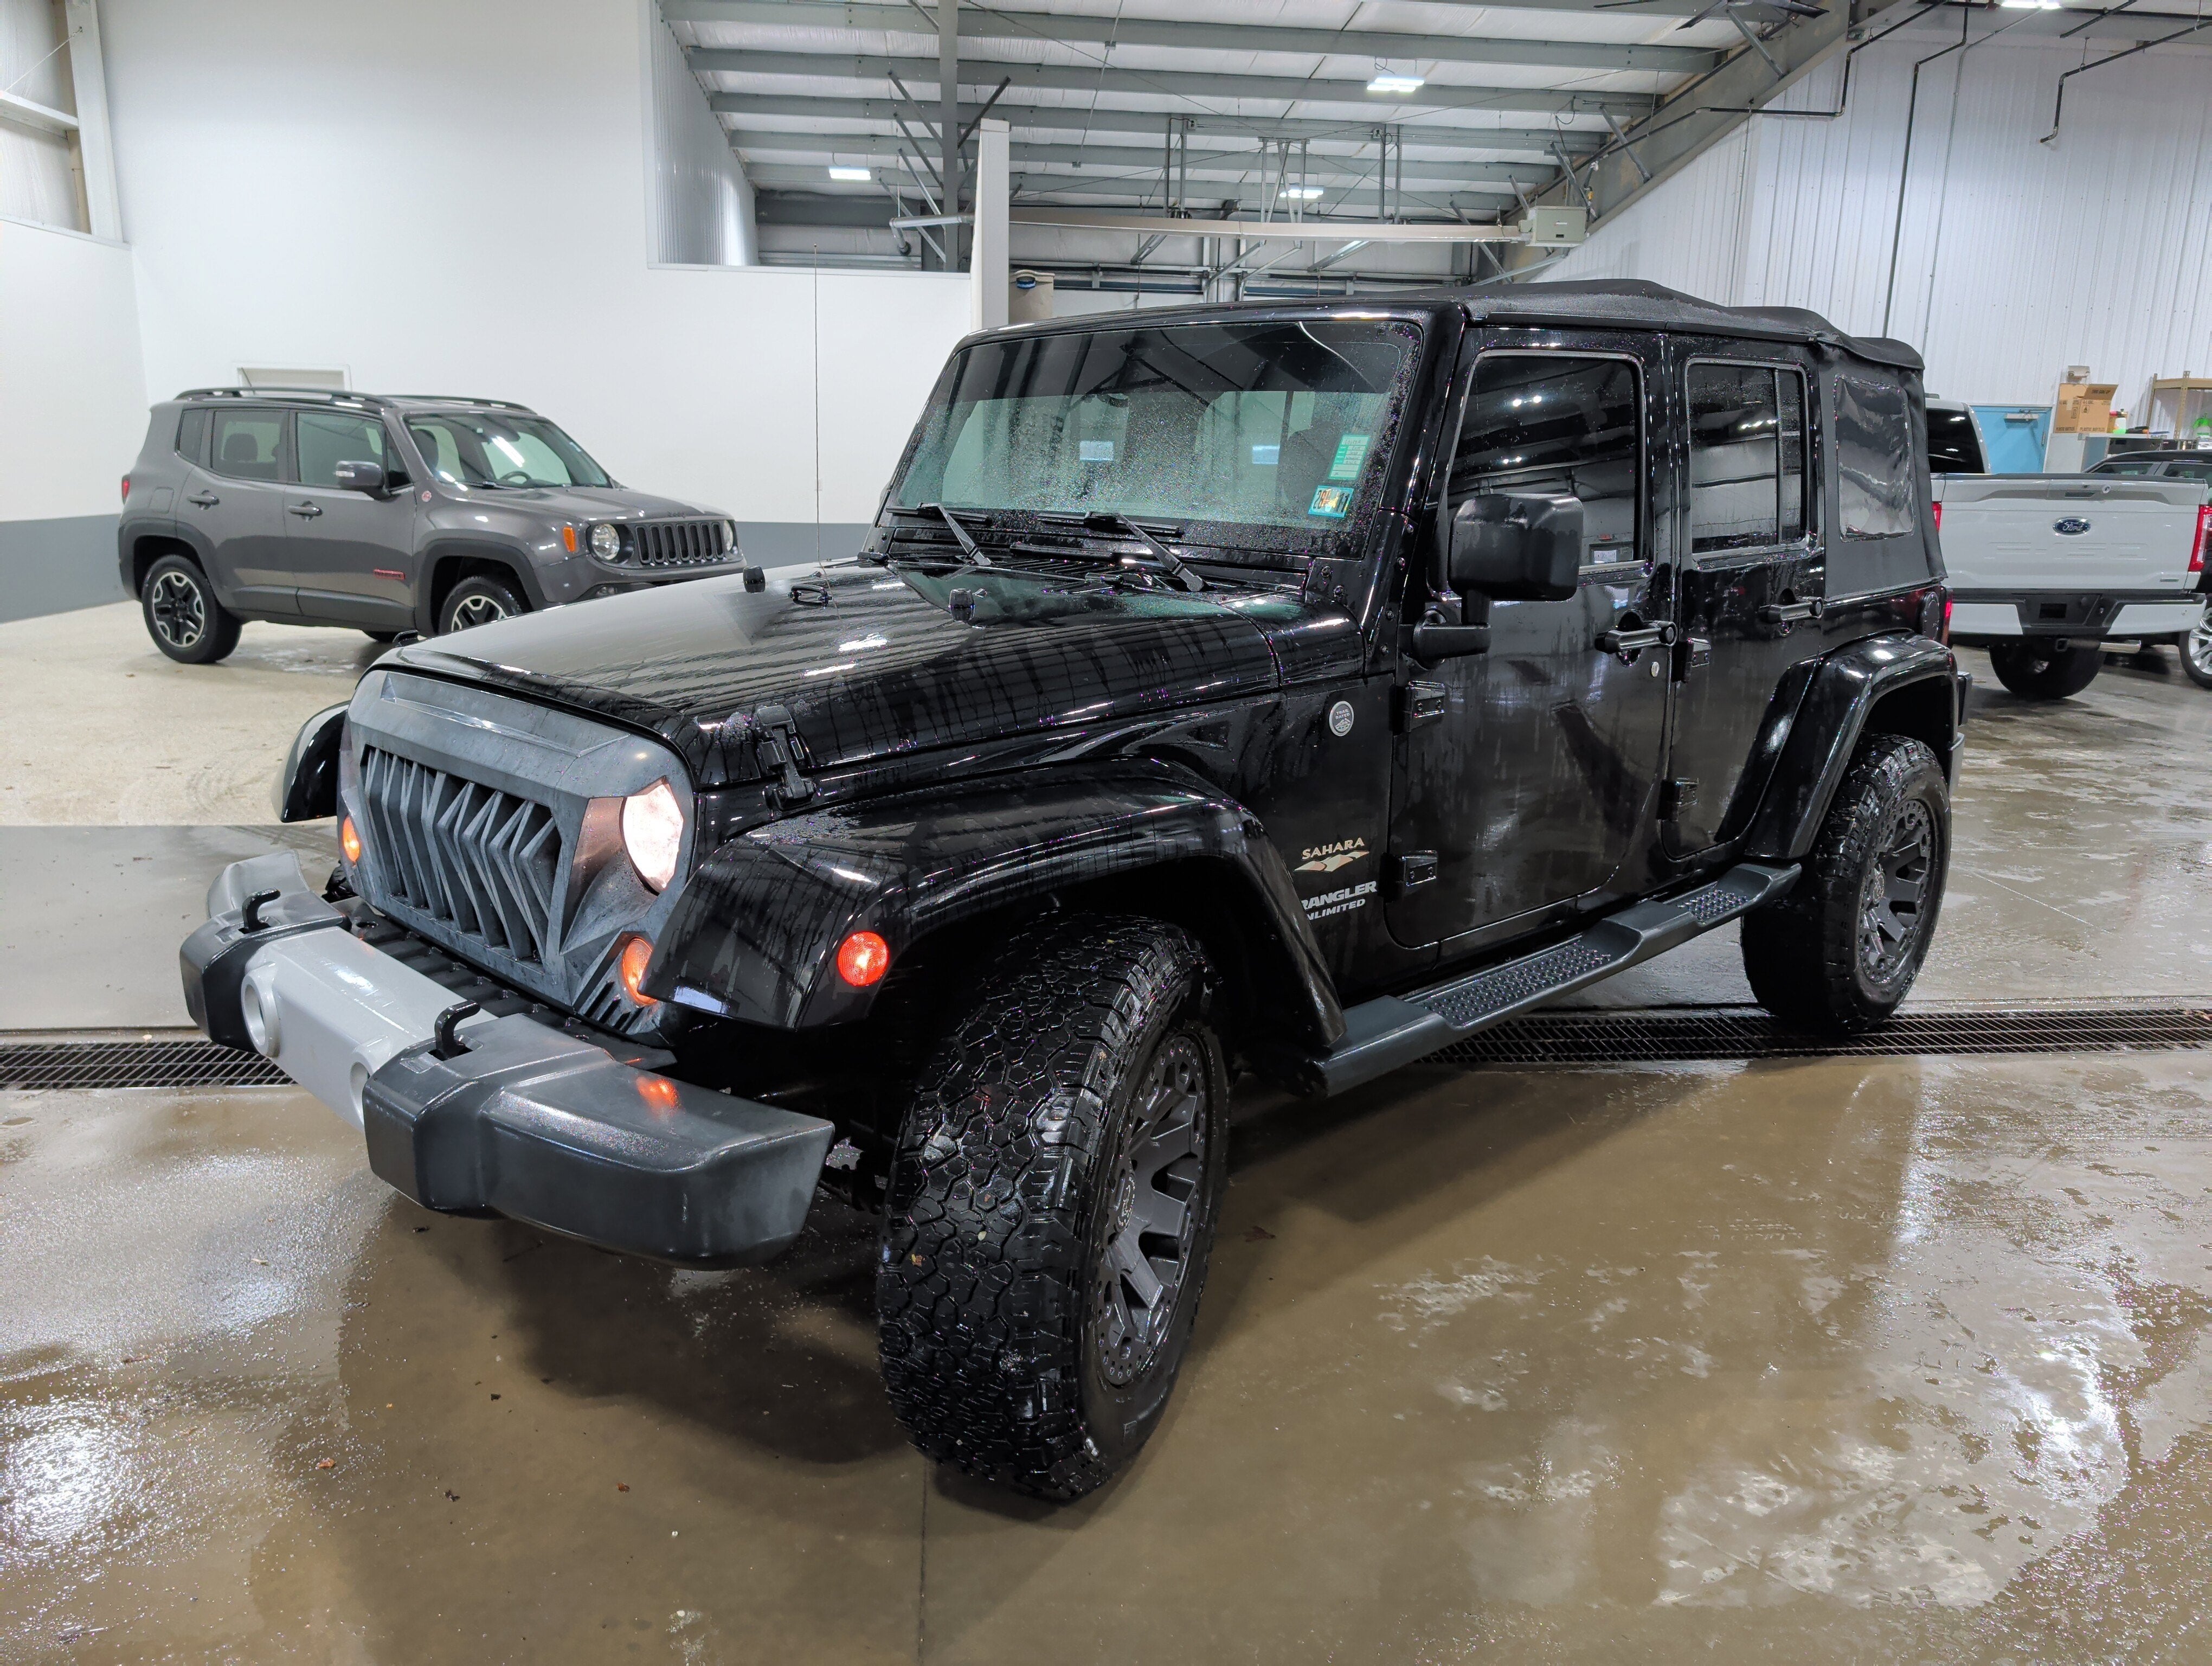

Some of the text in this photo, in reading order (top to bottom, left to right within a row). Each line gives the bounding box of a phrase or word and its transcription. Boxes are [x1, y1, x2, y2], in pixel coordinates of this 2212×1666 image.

[2062, 521, 2084, 531] Ford
[1302, 837, 1365, 861] SAHARA
[1301, 881, 1378, 910] RANGLER
[1307, 899, 1366, 920] NLIMITED
